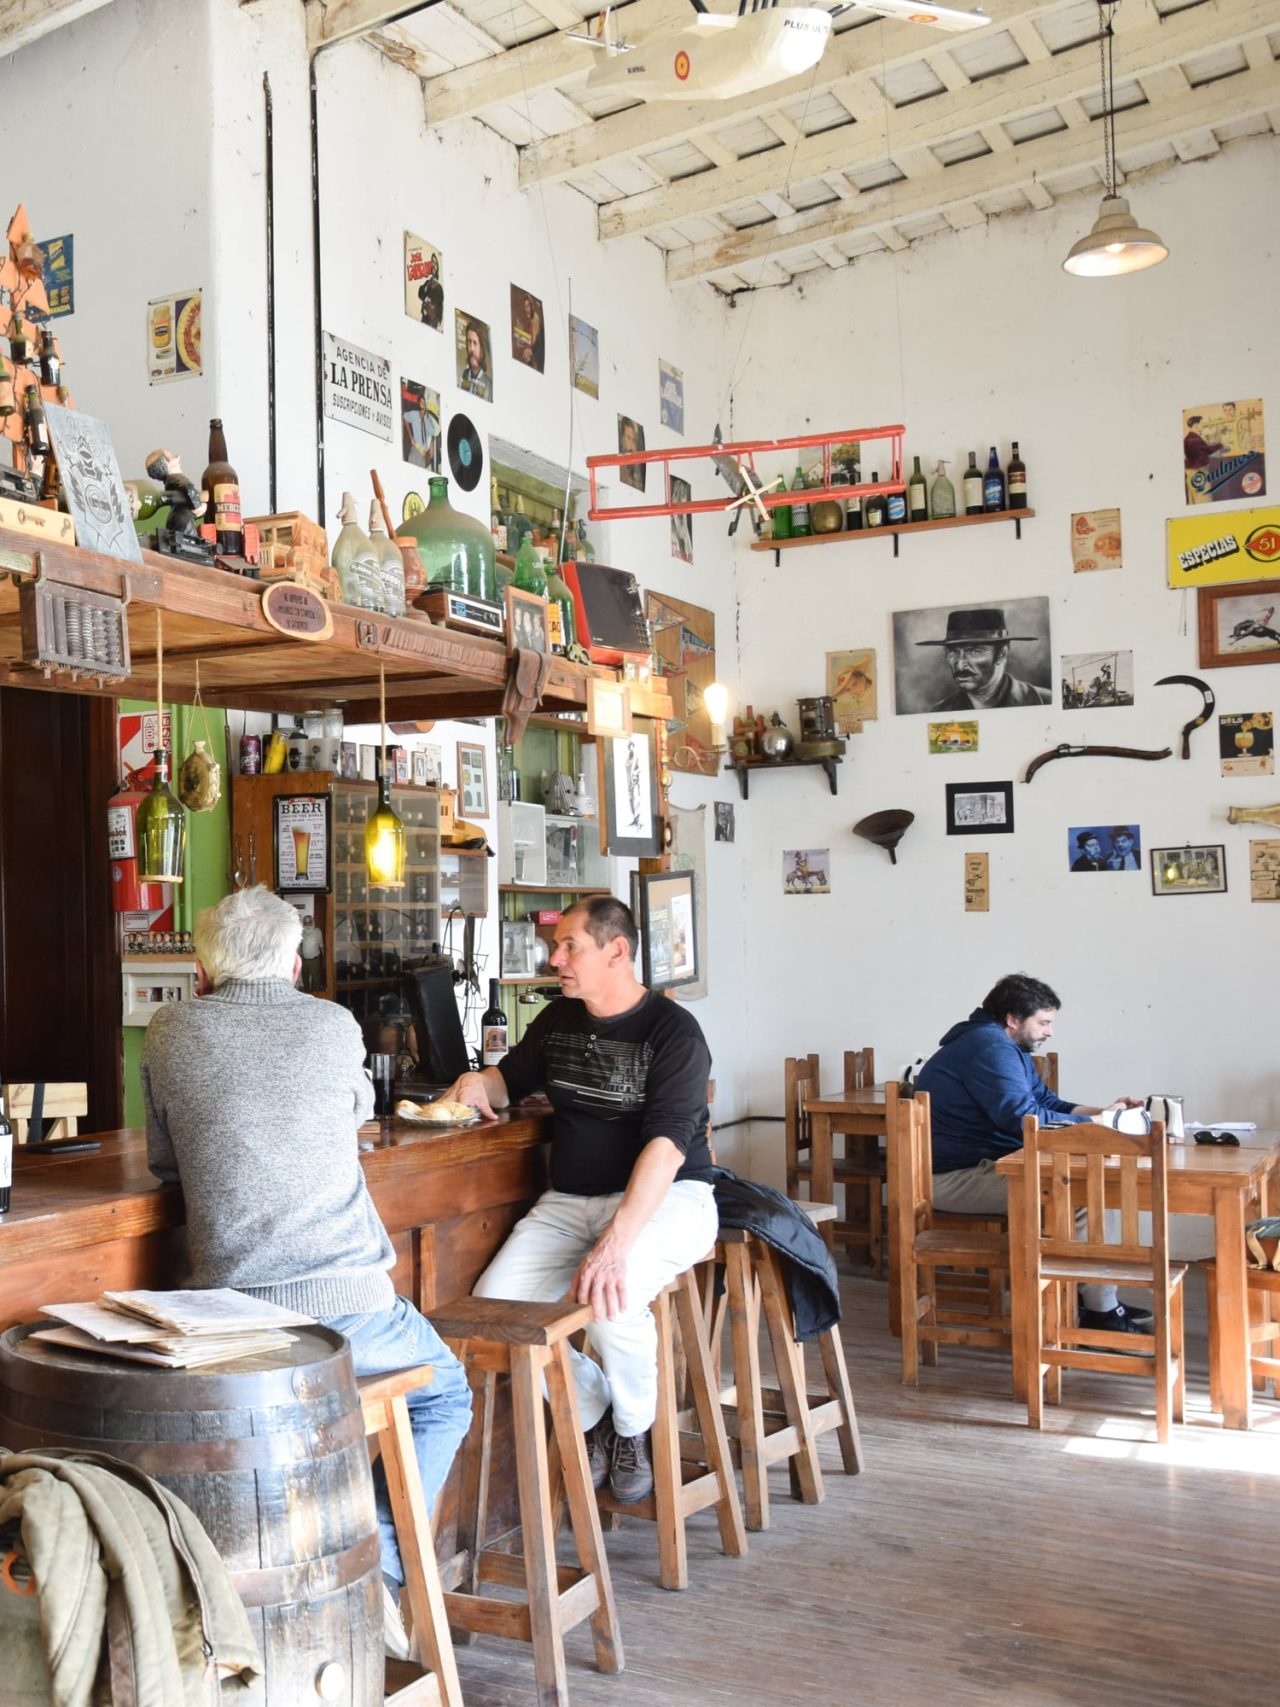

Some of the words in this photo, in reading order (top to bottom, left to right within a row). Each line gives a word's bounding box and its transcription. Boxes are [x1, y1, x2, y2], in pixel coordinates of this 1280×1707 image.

[784, 19, 810, 31] PLUS
[336, 346, 375, 374] AGENCIA
[377, 365, 388, 380] DE
[330, 362, 348, 389] LA
[351, 370, 392, 410] PRENSA
[332, 393, 371, 420] SUSCRIPCIONES
[376, 411, 392, 429] AVISOS
[1177, 534, 1239, 571] ESPECIAS
[1259, 537, 1276, 551] 51
[281, 803, 322, 814] BEER
